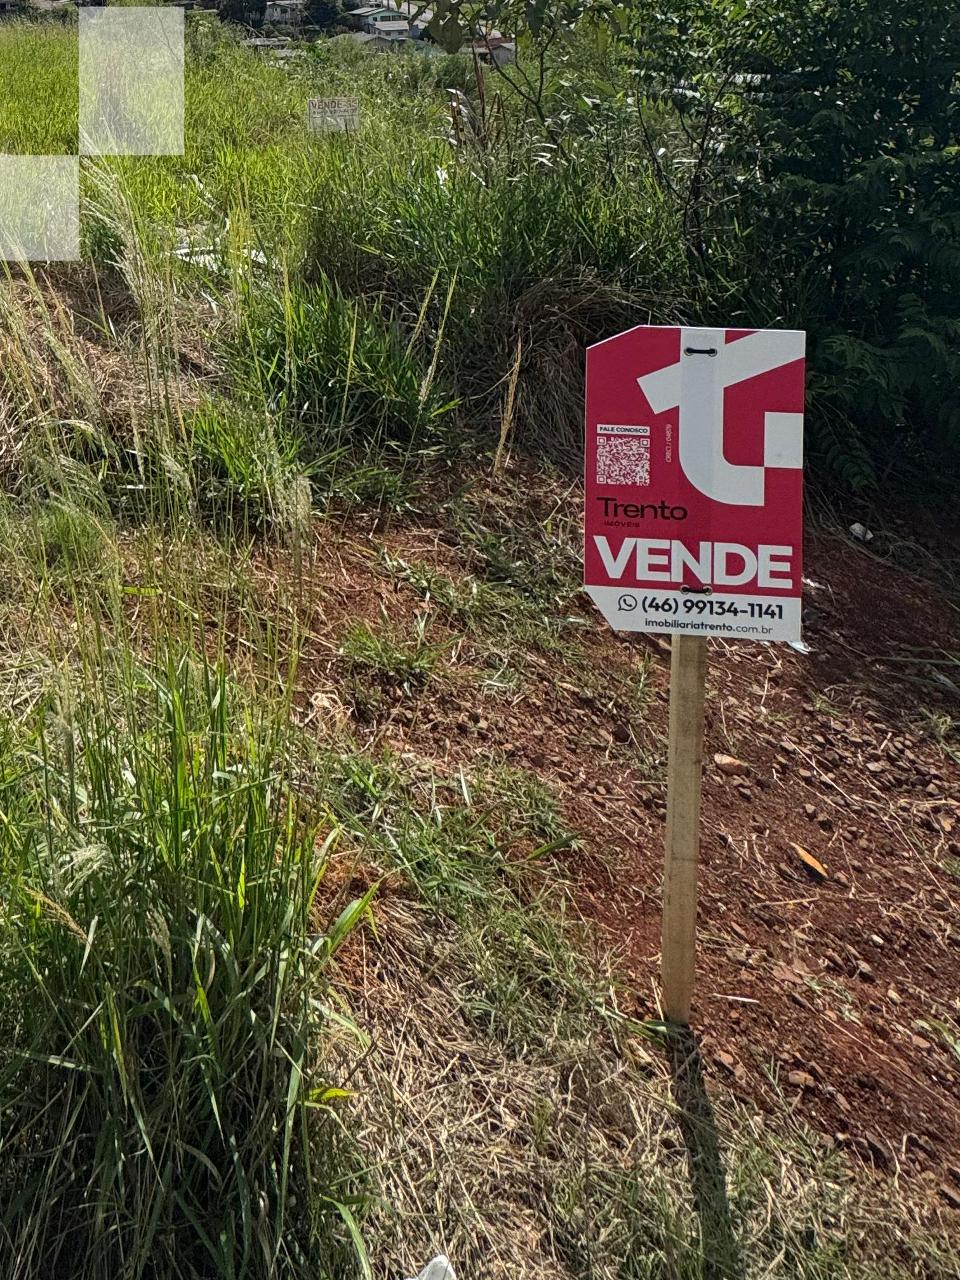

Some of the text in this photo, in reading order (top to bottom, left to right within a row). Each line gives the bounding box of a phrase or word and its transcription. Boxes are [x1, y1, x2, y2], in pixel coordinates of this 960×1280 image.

[616, 426, 648, 434] CONOSCO
[596, 496, 688, 521] Trento
[593, 535, 793, 589] VENDE
[641, 595, 783, 620] (46) 99134-1141
[644, 617, 773, 635] imobiliariatrento.com.br
